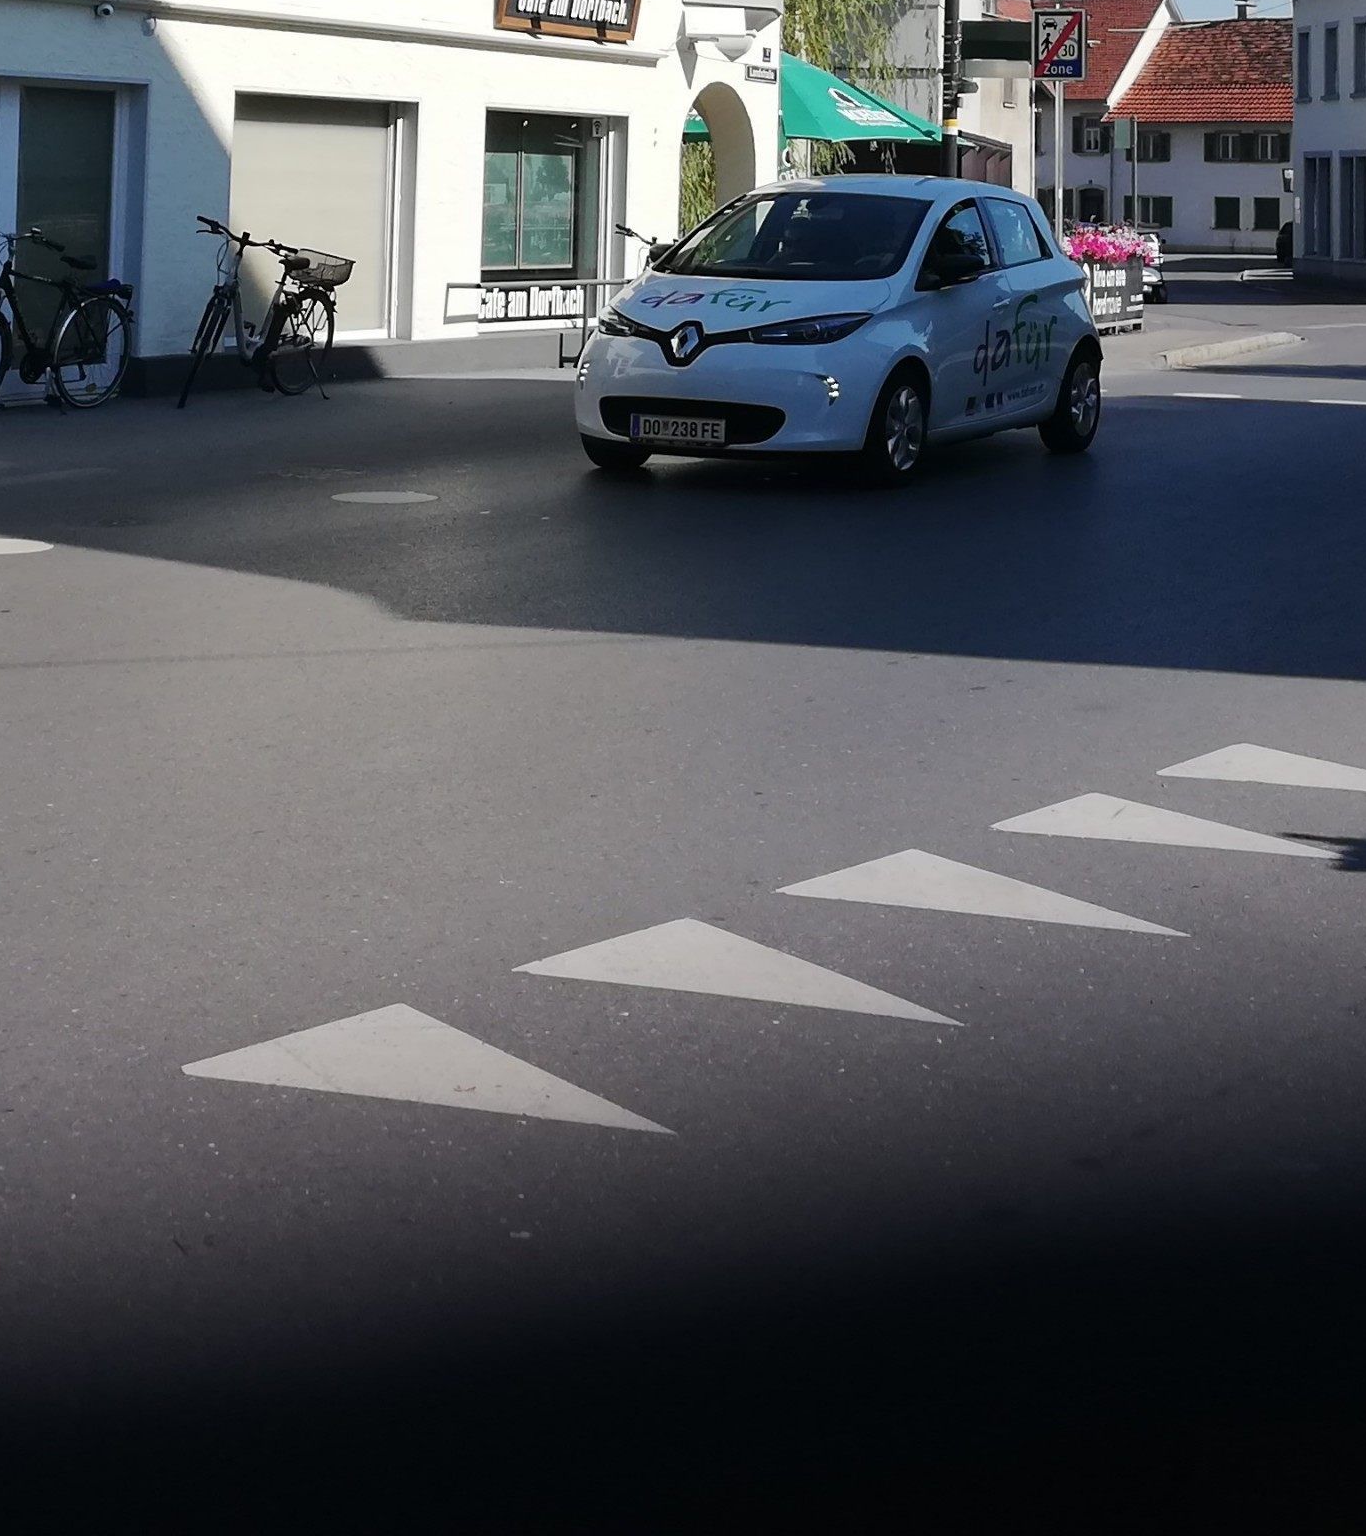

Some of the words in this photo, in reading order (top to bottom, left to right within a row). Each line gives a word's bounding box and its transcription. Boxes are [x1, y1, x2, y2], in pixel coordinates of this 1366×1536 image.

[1061, 44, 1075, 57] 30
[1043, 63, 1073, 75] Zone
[507, 291, 528, 318] am
[640, 288, 792, 313] dafür
[973, 293, 1058, 387] dafür
[643, 419, 661, 435] DO
[671, 421, 698, 438] 238
[701, 422, 721, 439] FE
